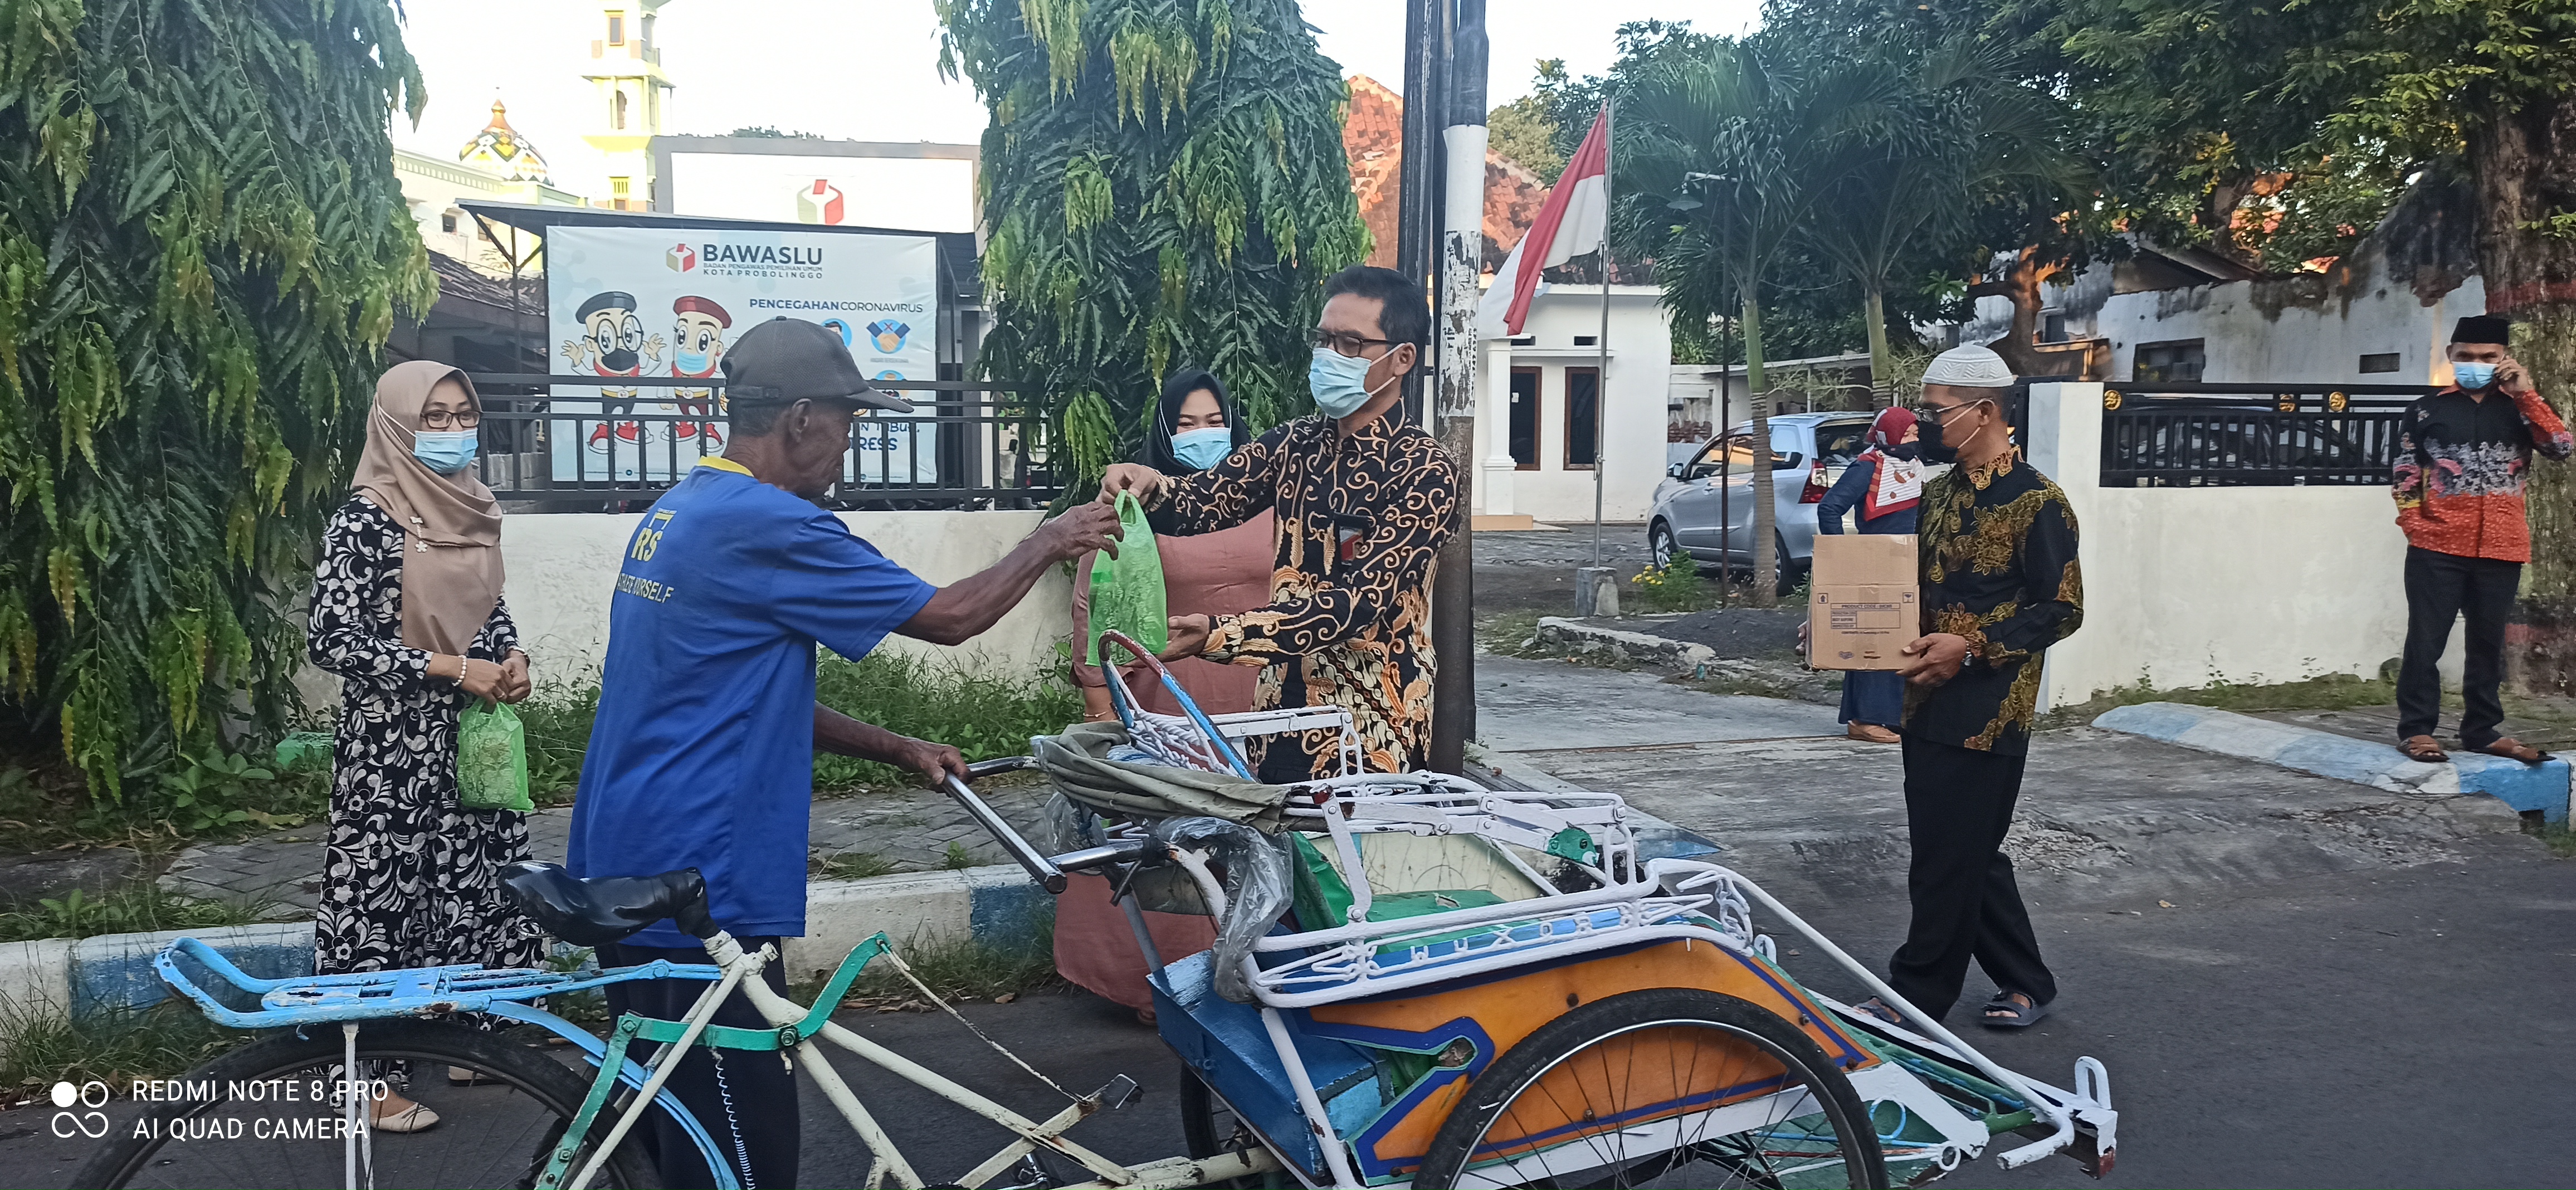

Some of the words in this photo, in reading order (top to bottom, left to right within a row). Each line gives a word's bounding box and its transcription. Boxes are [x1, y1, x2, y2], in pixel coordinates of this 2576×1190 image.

[703, 244, 822, 265] BAWASLU
[738, 270, 822, 279] PROBOLINGGO
[749, 299, 839, 310] PENCEGAHAN
[840, 301, 923, 313] CORONAVIRUS
[631, 527, 663, 562] RS
